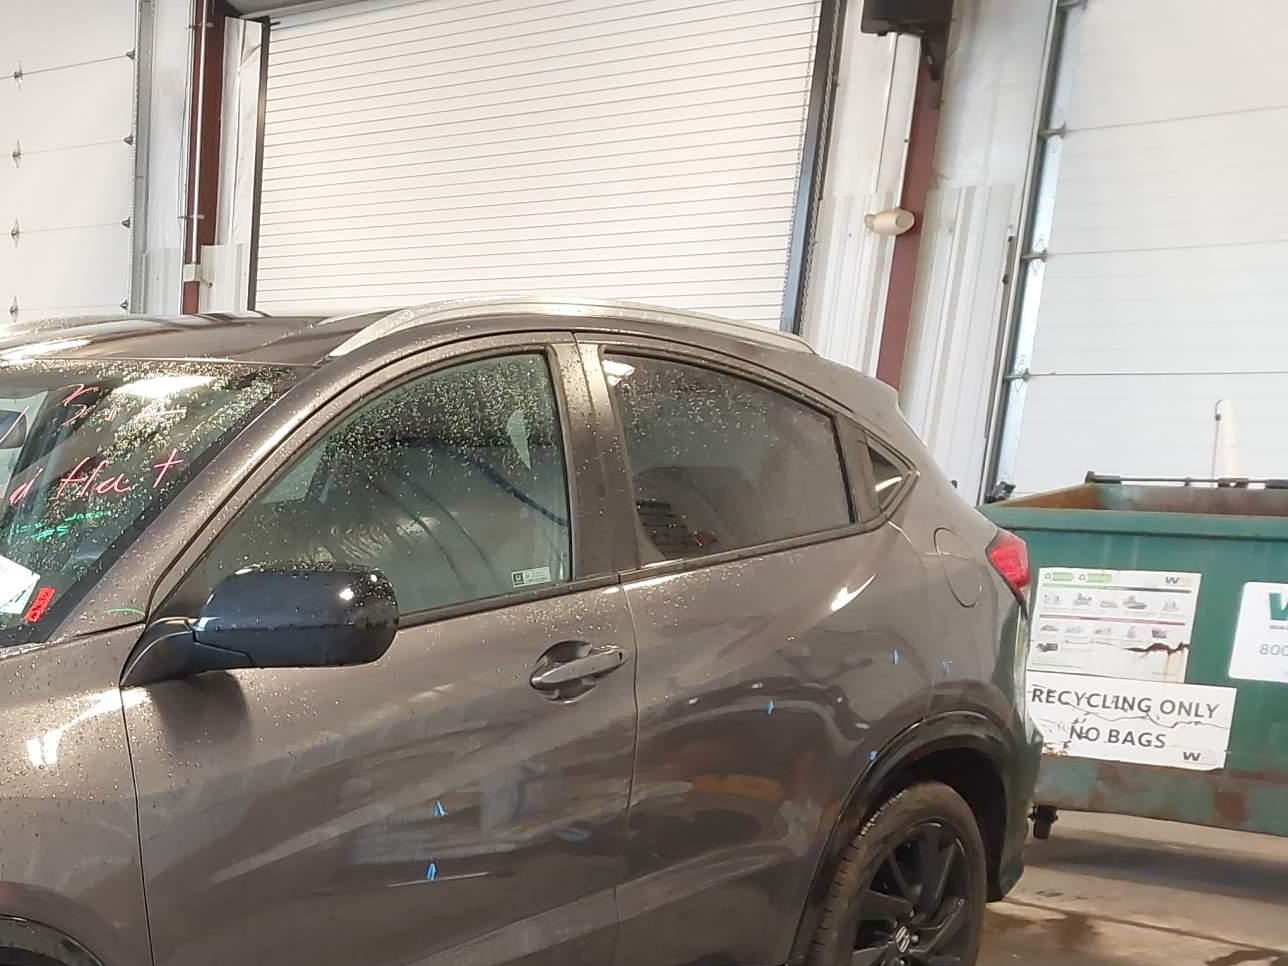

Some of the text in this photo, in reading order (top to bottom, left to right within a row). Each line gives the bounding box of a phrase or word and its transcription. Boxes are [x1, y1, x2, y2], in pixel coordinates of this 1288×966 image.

[1031, 688, 1219, 719] RECYCLING ONLY
[1069, 725, 1167, 749] NO BAGS
